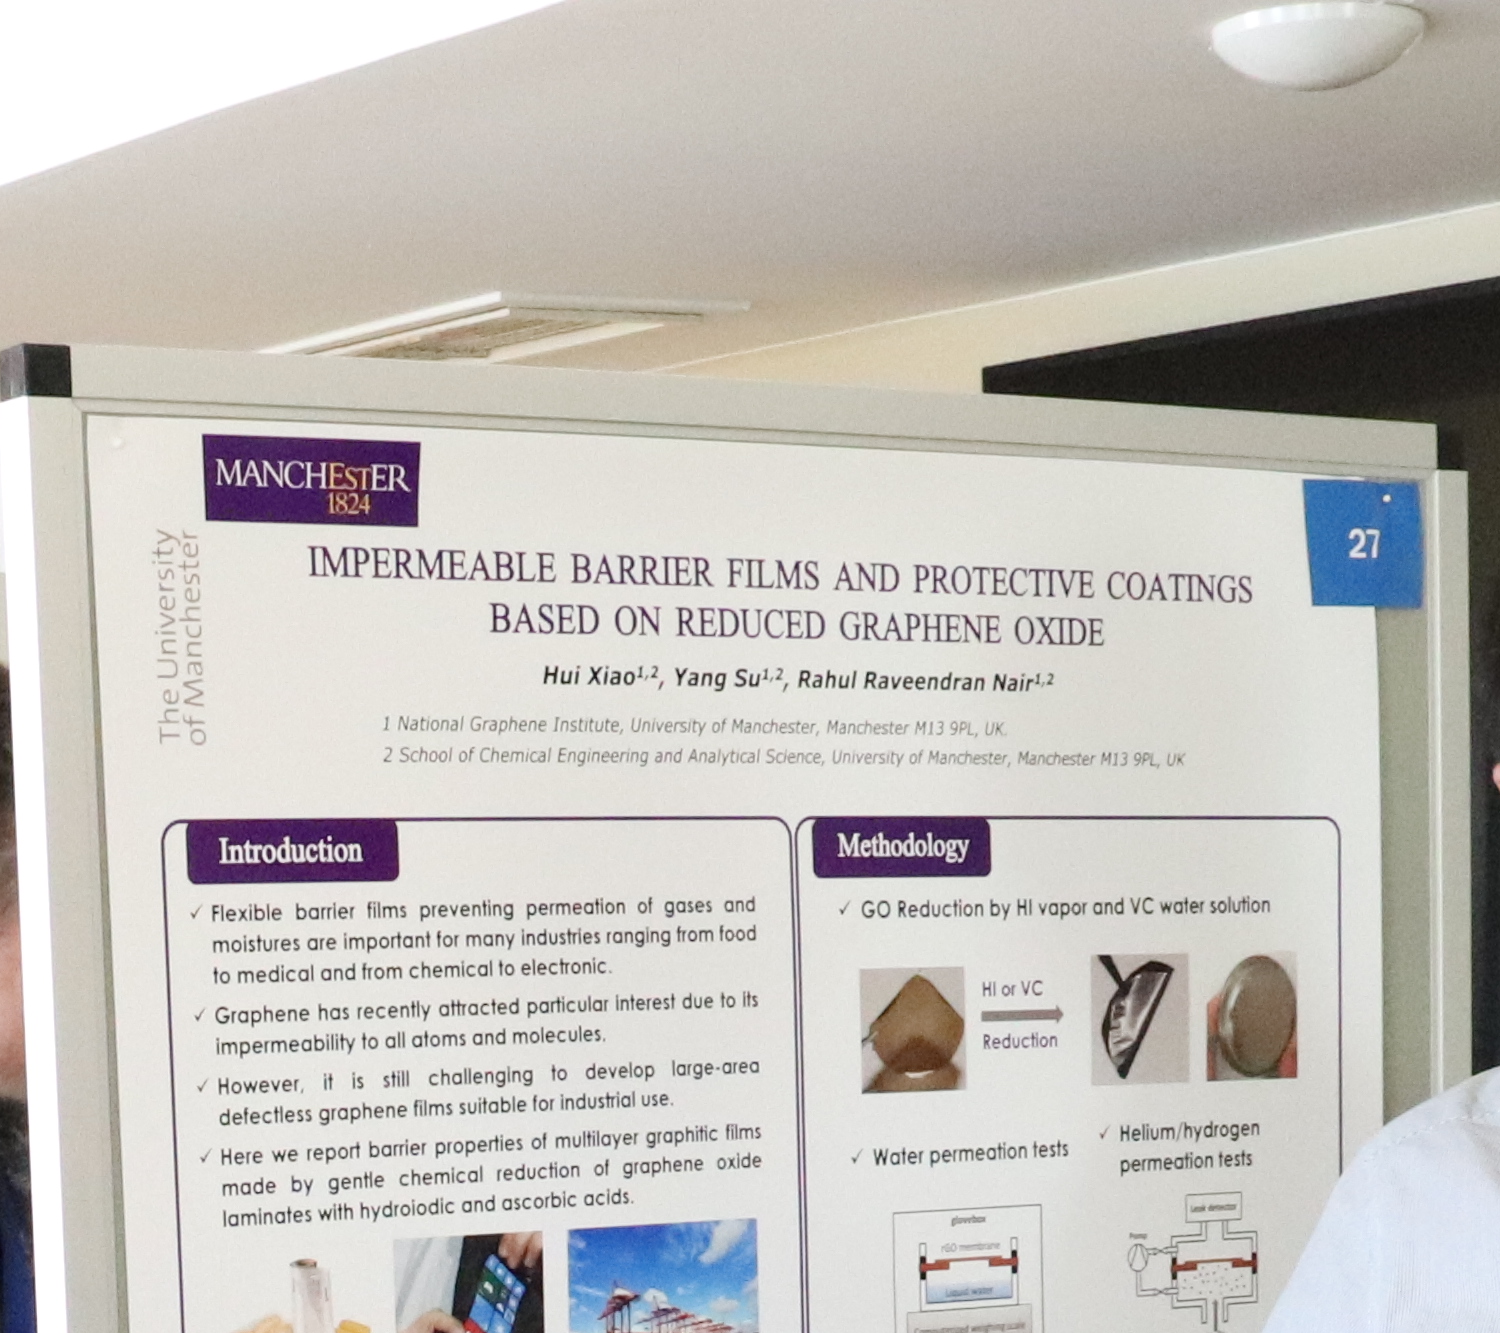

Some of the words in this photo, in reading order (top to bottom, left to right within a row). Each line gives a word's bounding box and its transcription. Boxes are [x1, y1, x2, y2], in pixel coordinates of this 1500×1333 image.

[216, 458, 411, 492] MANCHESTER
[327, 493, 372, 516] 1824
[1347, 528, 1382, 559] 27
[308, 546, 556, 583] IMPERMEABLE
[571, 553, 713, 587] BARRIER
[727, 558, 819, 590] FILMS
[834, 562, 900, 592] AND
[914, 564, 1094, 599] PROTECTIVE
[1107, 571, 1252, 604] COATINGS
[151, 529, 181, 680] University
[178, 530, 205, 708] Manchester
[490, 603, 599, 634] BASED
[615, 605, 660, 636] ON
[676, 607, 825, 639] REDUCED
[840, 611, 1001, 644] GRAPHENE
[1014, 616, 1104, 646] OXIDE
[543, 666, 580, 685] Hui
[675, 668, 727, 692] Yang
[798, 670, 857, 689] Rahul
[864, 671, 985, 691] Raveendran
[158, 689, 181, 745] The
[188, 713, 207, 747] of
[383, 716, 389, 731] 1
[398, 715, 464, 732] National
[470, 716, 547, 735] Graphene
[553, 716, 624, 735] Institute,
[631, 717, 707, 737] University
[712, 718, 727, 734] of
[731, 718, 819, 737] Manchester,
[827, 720, 910, 735] Manchester
[915, 721, 944, 736] M13
[950, 720, 978, 738] 9PL,
[219, 835, 363, 864] Introduction
[837, 832, 970, 863] Methodology
[212, 904, 282, 922] Flexible
[296, 902, 355, 920] barrier
[367, 901, 407, 919] films
[420, 899, 514, 922] preventing
[526, 898, 625, 920] permeation
[637, 897, 653, 914] of
[664, 900, 712, 918] gases
[724, 896, 755, 913] and
[861, 900, 891, 919] GO
[898, 899, 984, 918] Reduction
[990, 899, 1011, 920] by
[1017, 899, 1032, 916] HI
[1039, 902, 1087, 920] vapor
[1093, 897, 1124, 915] and
[1130, 897, 1154, 915] VC
[1160, 897, 1204, 914] water
[1210, 896, 1270, 914] solution
[982, 982, 996, 996] HI
[1001, 984, 1016, 997] or
[1021, 980, 1043, 996] VC
[983, 1032, 1058, 1049] Reduction
[1120, 1121, 1260, 1142] Helium/hydrogen
[873, 1148, 923, 1166] Water
[930, 1142, 1027, 1168] permeation
[1033, 1140, 1069, 1158] tests
[1120, 1152, 1214, 1177] permeation
[1218, 1150, 1252, 1167] tests
